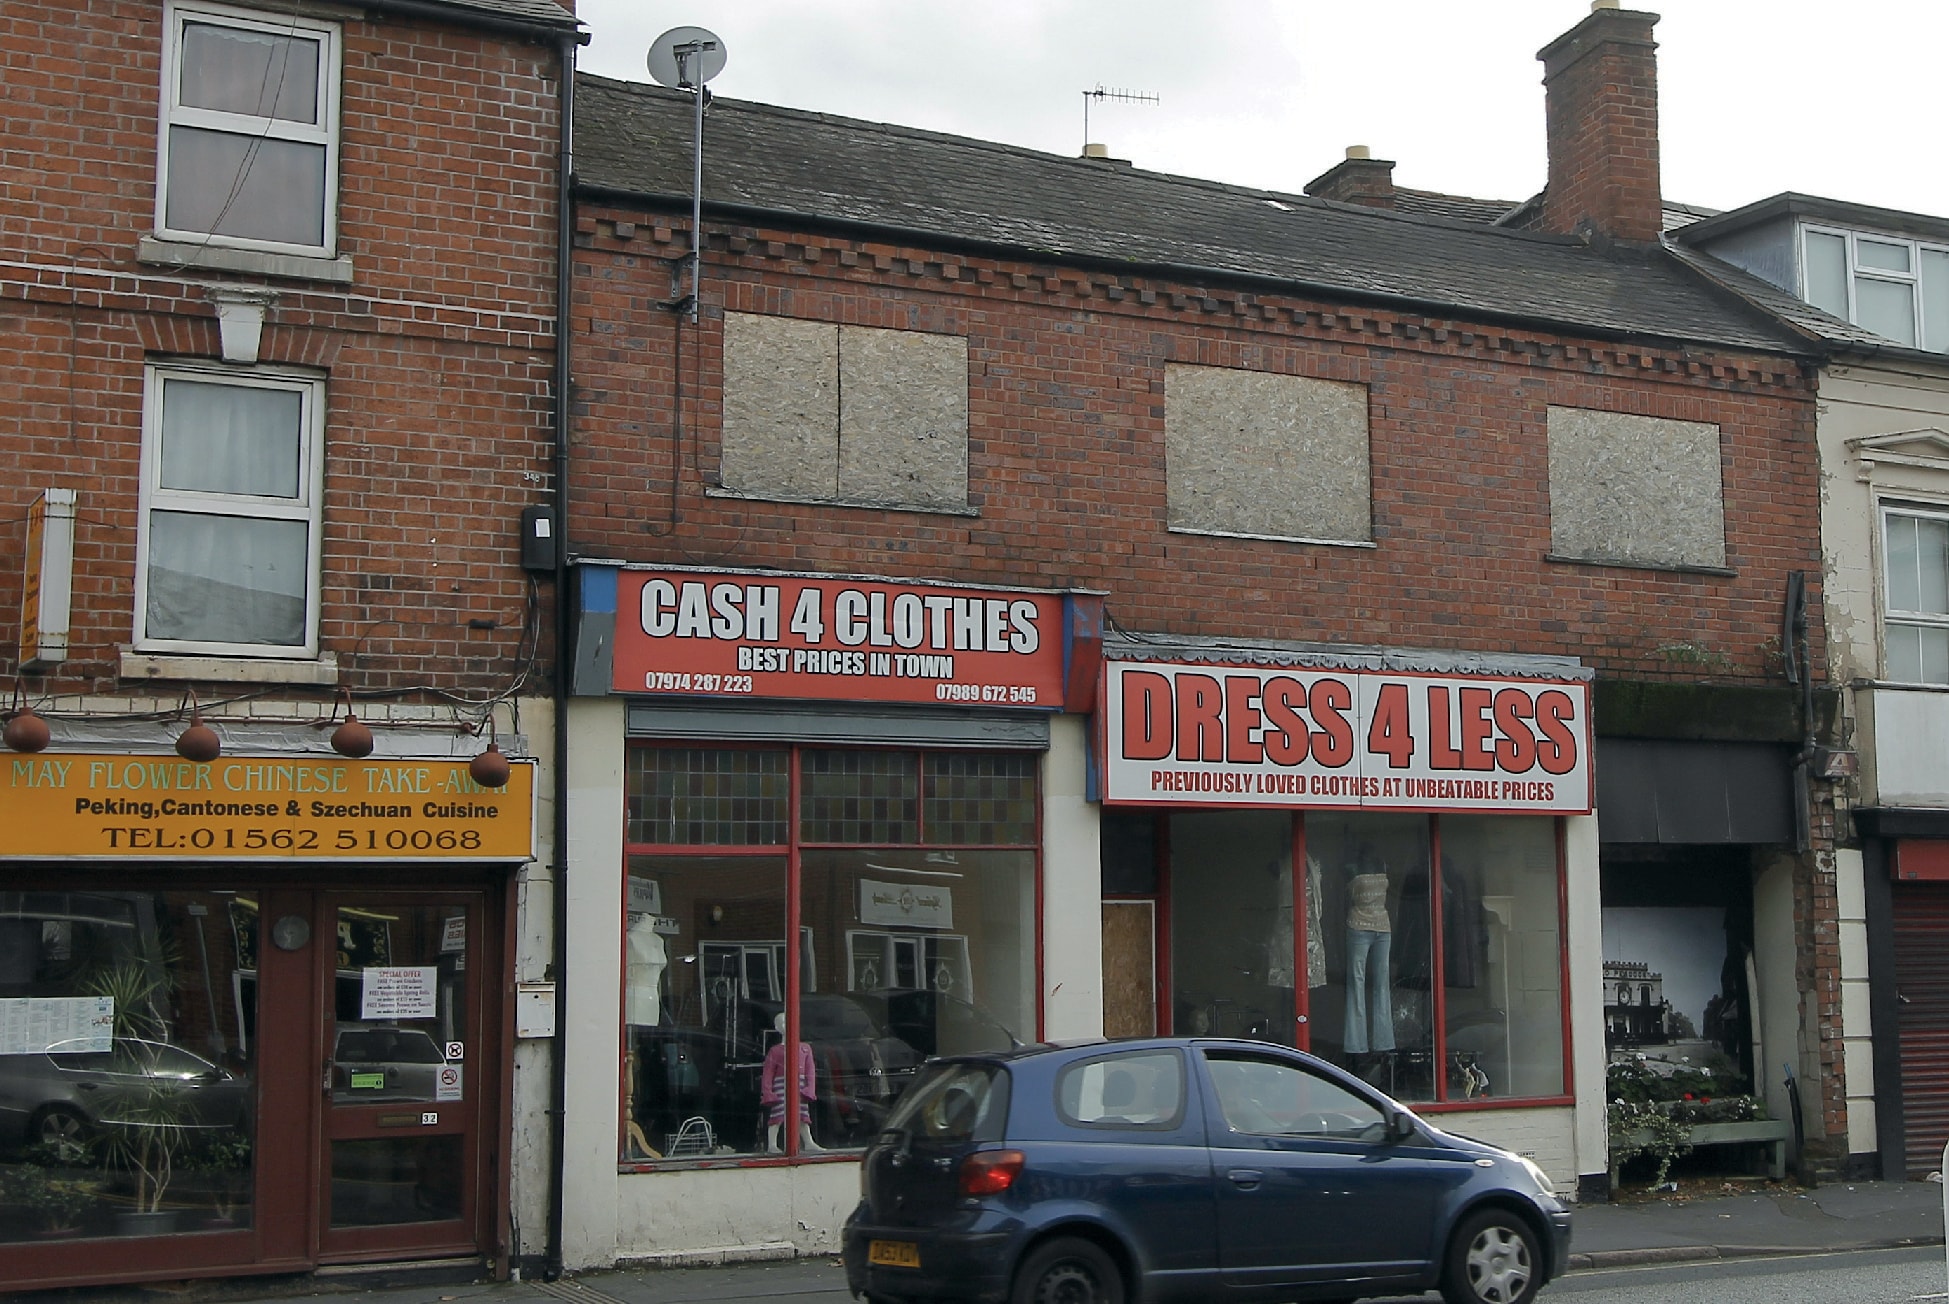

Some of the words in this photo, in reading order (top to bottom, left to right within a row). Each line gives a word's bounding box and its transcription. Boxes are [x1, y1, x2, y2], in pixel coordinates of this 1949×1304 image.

[640, 578, 780, 641] CASH
[790, 587, 825, 643] 4
[835, 589, 1040, 654] CLOTHES
[737, 646, 790, 673] BEST
[793, 650, 865, 676] PRICES
[869, 652, 890, 676] IN
[894, 653, 954, 679] TOWN
[645, 671, 692, 691] 07974
[693, 673, 721, 692] 287
[723, 675, 752, 693] 223
[936, 682, 981, 701] 07989
[982, 684, 1006, 702] 672
[1009, 685, 1037, 703] 545
[1121, 669, 1354, 769] DRESS
[1367, 682, 1415, 769] 4
[1427, 685, 1577, 775] LESS
[10, 761, 71, 788] MAY
[88, 762, 212, 791] FLOWER
[223, 764, 348, 793] CHINESE
[1151, 770, 1252, 793] PREVIOUSLY
[1256, 773, 1306, 795] LOVED
[1310, 775, 1380, 797] CLOTHES
[1383, 777, 1401, 798] AT
[1405, 778, 1498, 800] UNBEATABLE
[1502, 780, 1554, 801] PRICES
[286, 800, 301, 817] &
[311, 801, 411, 818] Szechuan
[422, 801, 499, 819] Cuisine
[102, 827, 319, 850] TEL:01562
[335, 829, 482, 850] 510068
[423, 1114, 436, 1123] 32
